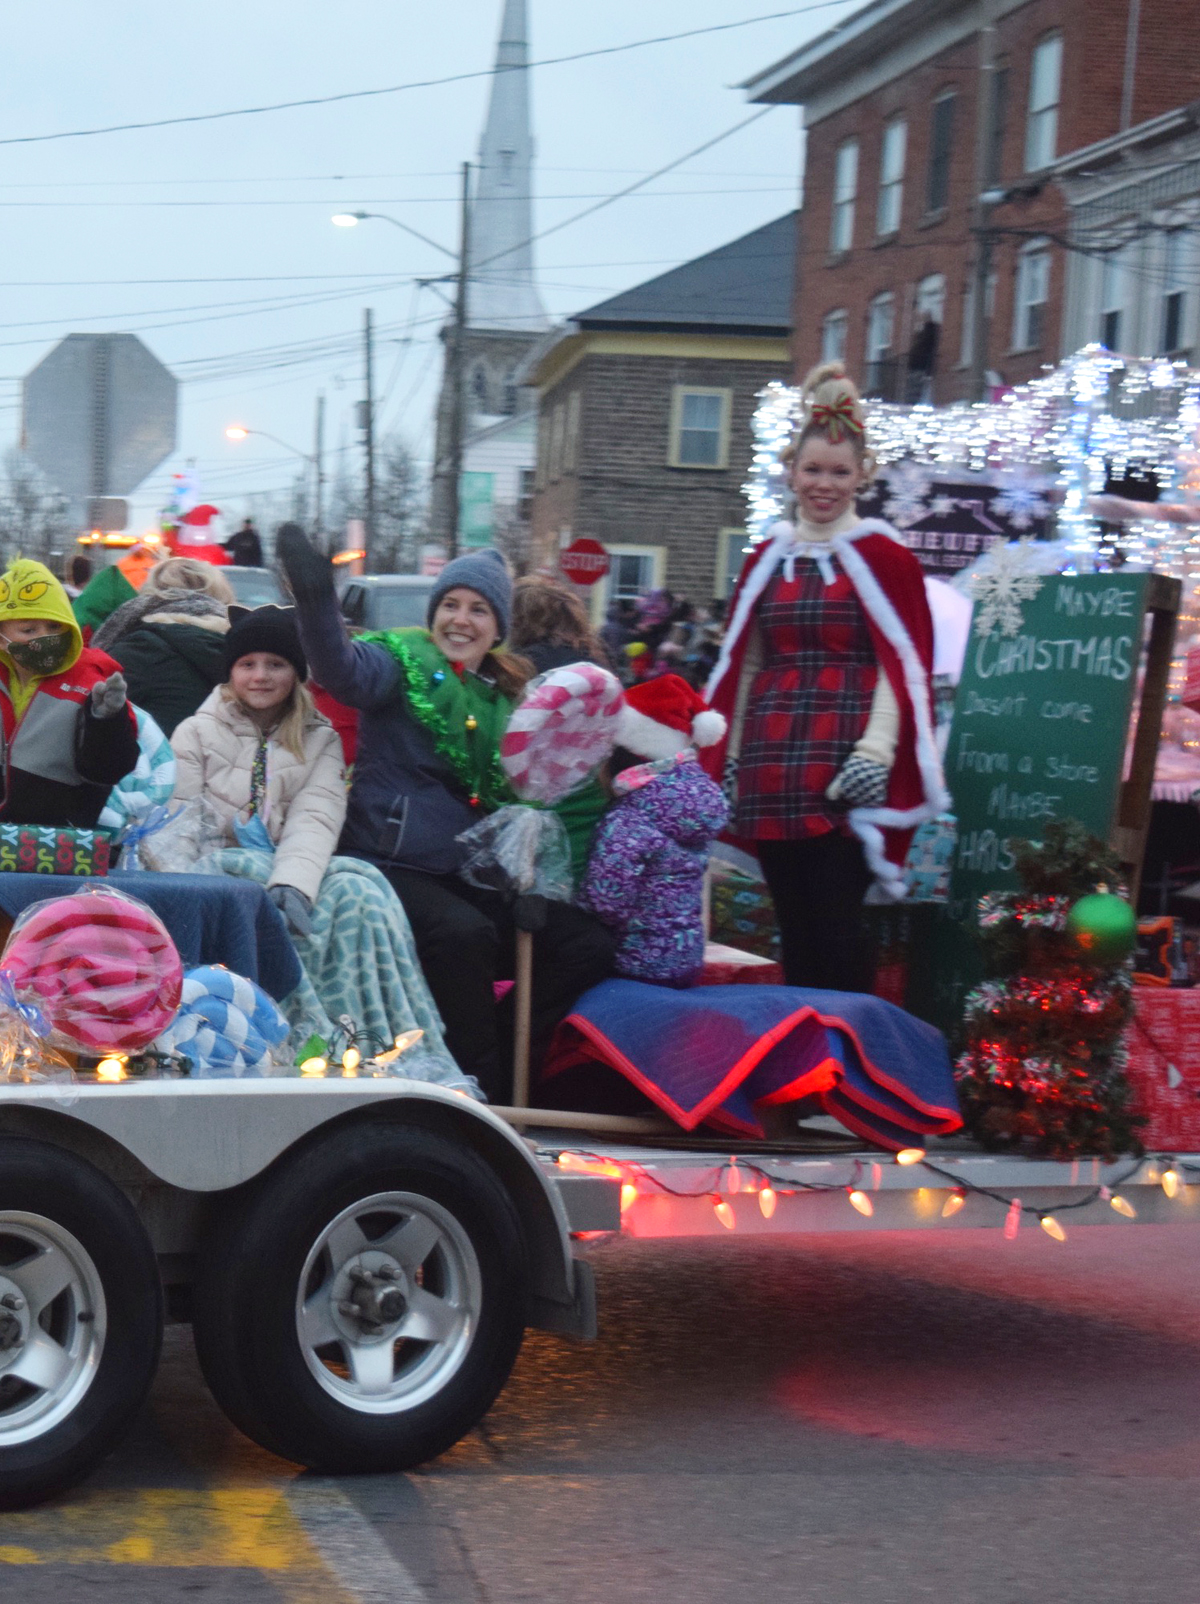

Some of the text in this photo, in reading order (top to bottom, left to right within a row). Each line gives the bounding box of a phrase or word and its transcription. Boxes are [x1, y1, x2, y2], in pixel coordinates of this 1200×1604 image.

[561, 551, 609, 571] STOP
[1054, 584, 1137, 617] MAYBE
[975, 632, 1133, 680] CHRISTMAS
[1017, 756, 1033, 775] a
